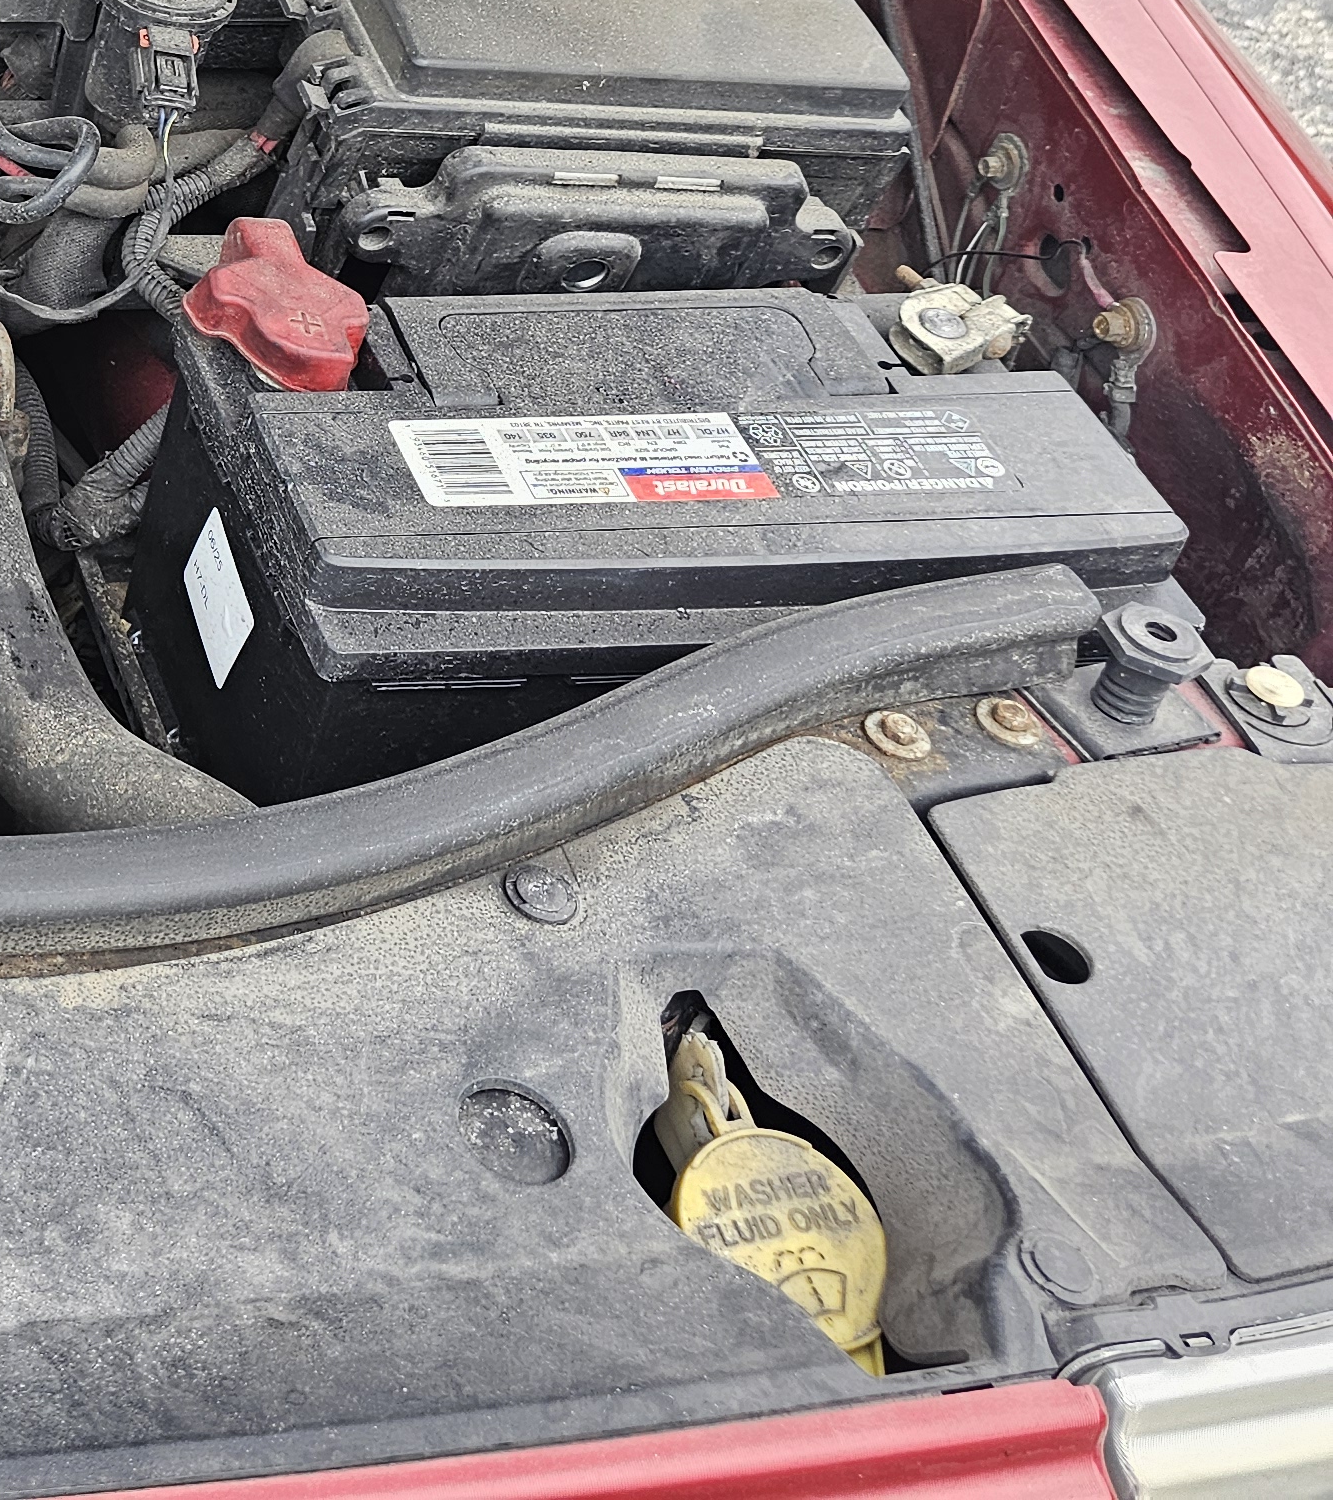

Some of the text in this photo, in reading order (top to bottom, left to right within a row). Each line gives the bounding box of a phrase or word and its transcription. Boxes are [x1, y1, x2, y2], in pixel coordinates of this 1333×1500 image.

[662, 417, 712, 425] DISTRIBUTED
[504, 432, 523, 440] 140
[634, 428, 657, 437] LN4
[664, 427, 682, 437] H7
[696, 426, 730, 436] H7-DL
[525, 457, 560, 465] recycling
[561, 457, 586, 465] proper
[599, 455, 637, 463] AutoZone
[645, 465, 739, 475] PROVEN TOUGH
[653, 478, 754, 495] Duralast
[836, 477, 981, 492] DANGER/POISON
[546, 487, 599, 496] WARNING:
[208, 529, 223, 572] 06/25
[193, 559, 209, 611] H7-DL
[701, 1169, 831, 1213] WASHER
[697, 1196, 861, 1247] FLUID ONLY
